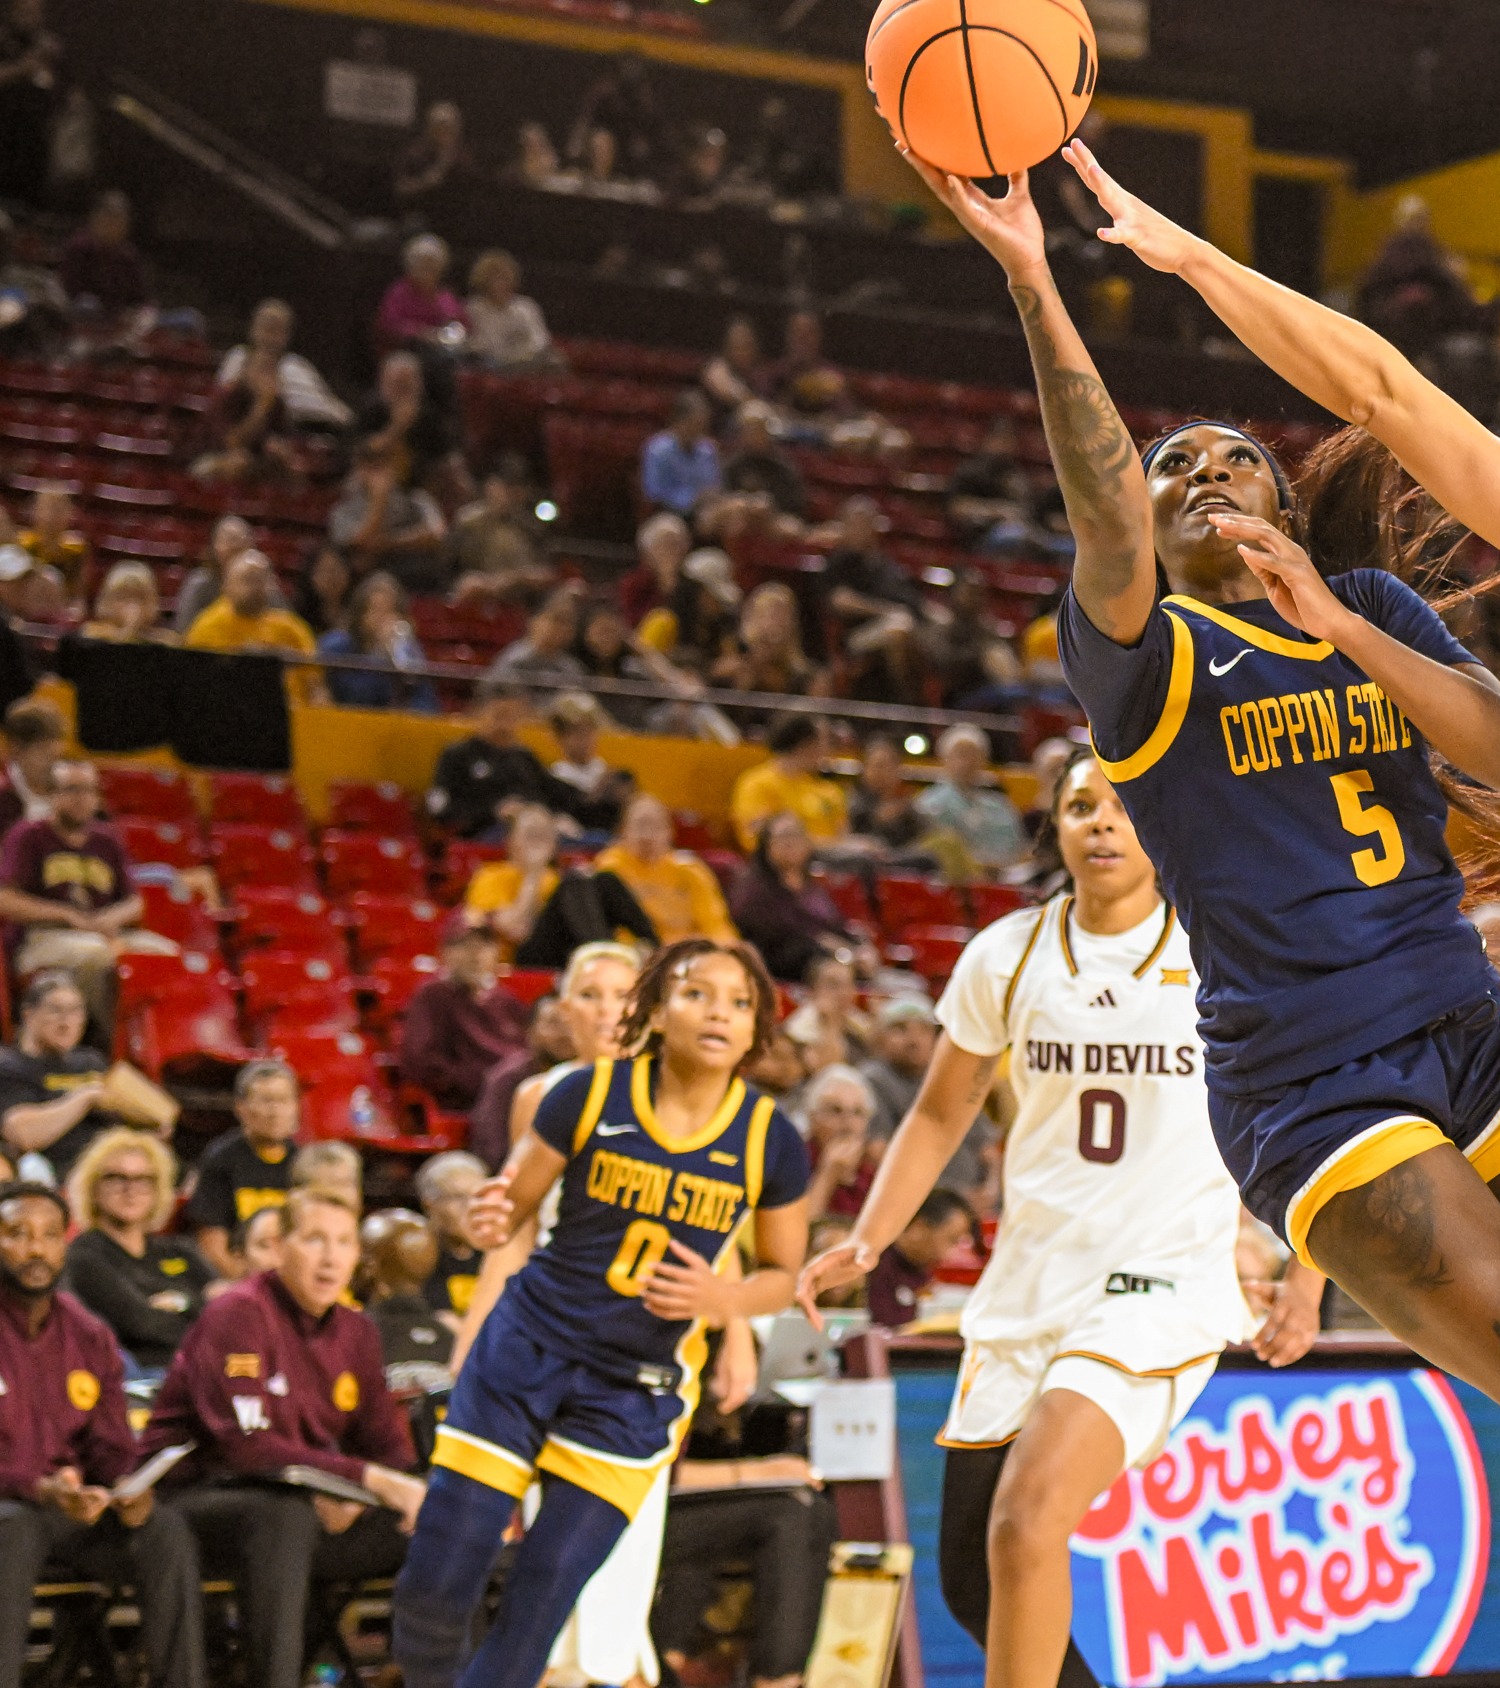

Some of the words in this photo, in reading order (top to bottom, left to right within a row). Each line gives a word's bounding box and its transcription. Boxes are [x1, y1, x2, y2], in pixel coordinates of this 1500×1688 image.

[1219, 688, 1341, 776] COPPIN
[1329, 769, 1406, 887] 5
[1027, 1039, 1073, 1073] SUN
[1084, 1044, 1196, 1075] DEVILS
[1078, 1088, 1126, 1164] 0
[586, 1149, 673, 1216] COPPIN
[667, 1172, 744, 1233] STATE
[606, 1219, 671, 1297] 0
[1115, 1502, 1422, 1684] Mike's
